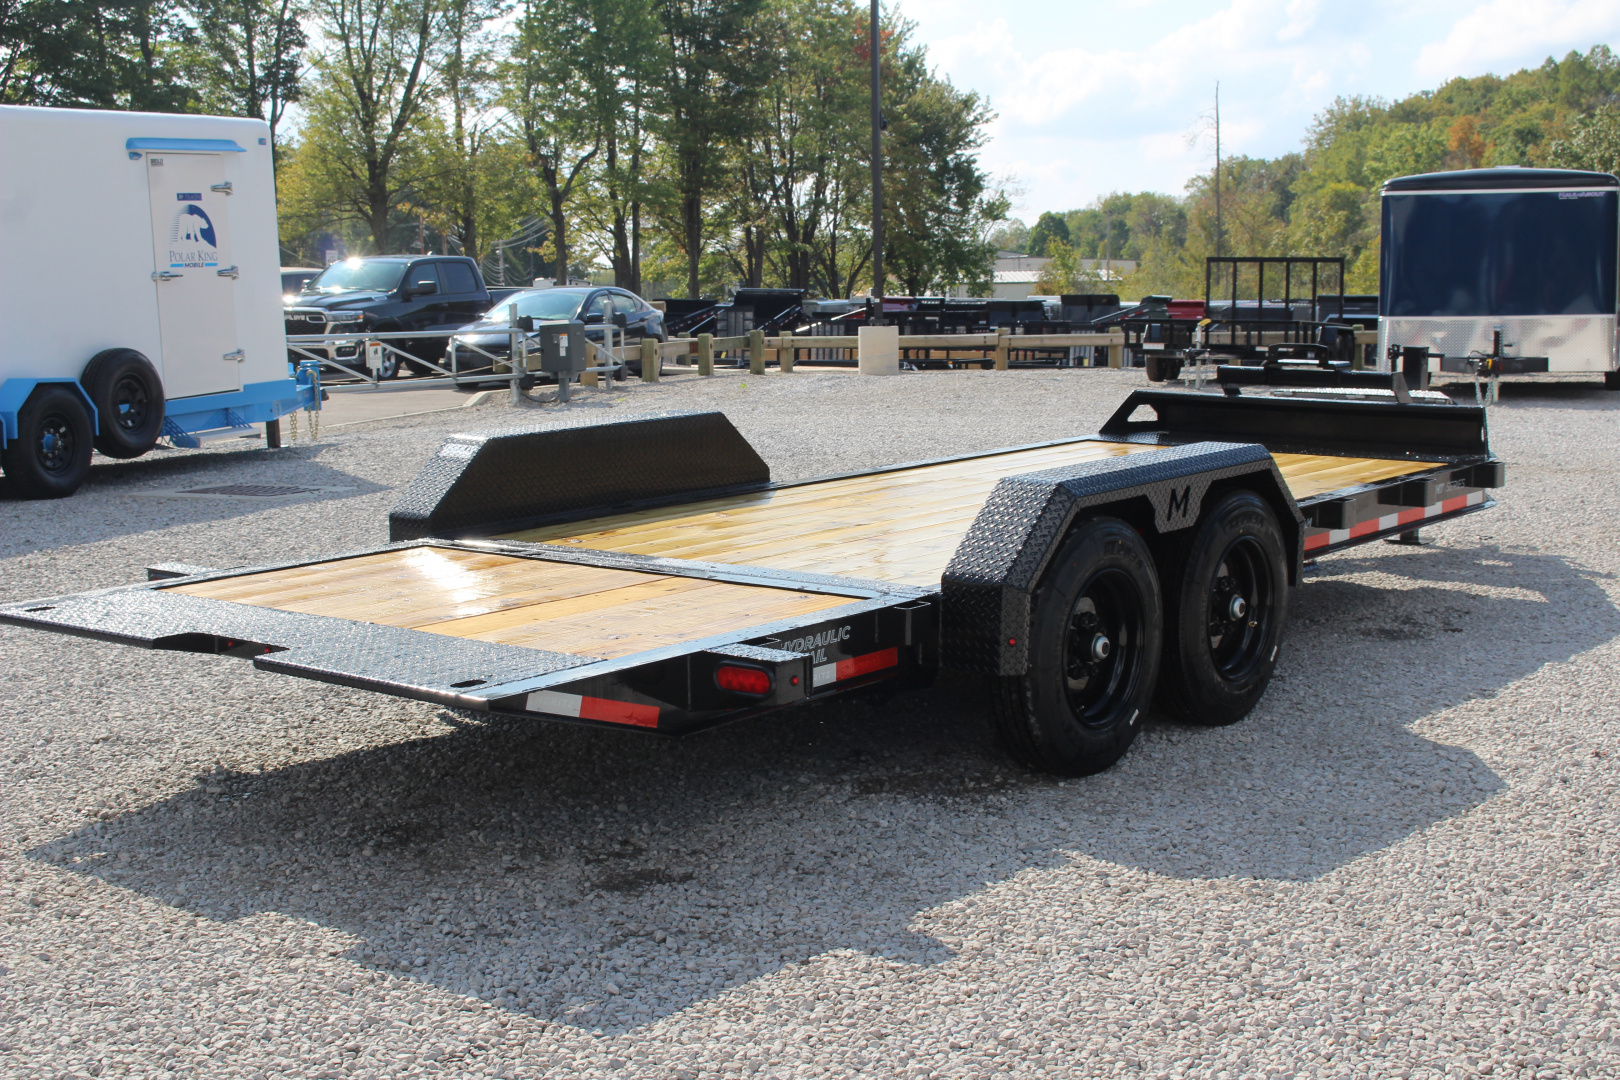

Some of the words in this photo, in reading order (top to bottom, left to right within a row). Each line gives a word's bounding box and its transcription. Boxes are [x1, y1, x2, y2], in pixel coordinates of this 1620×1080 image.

[169, 250, 196, 262] POLAR
[197, 250, 218, 262] KING
[1166, 485, 1191, 521] M
[780, 625, 852, 652] HYDRAULIC
[810, 648, 827, 664] AIL
